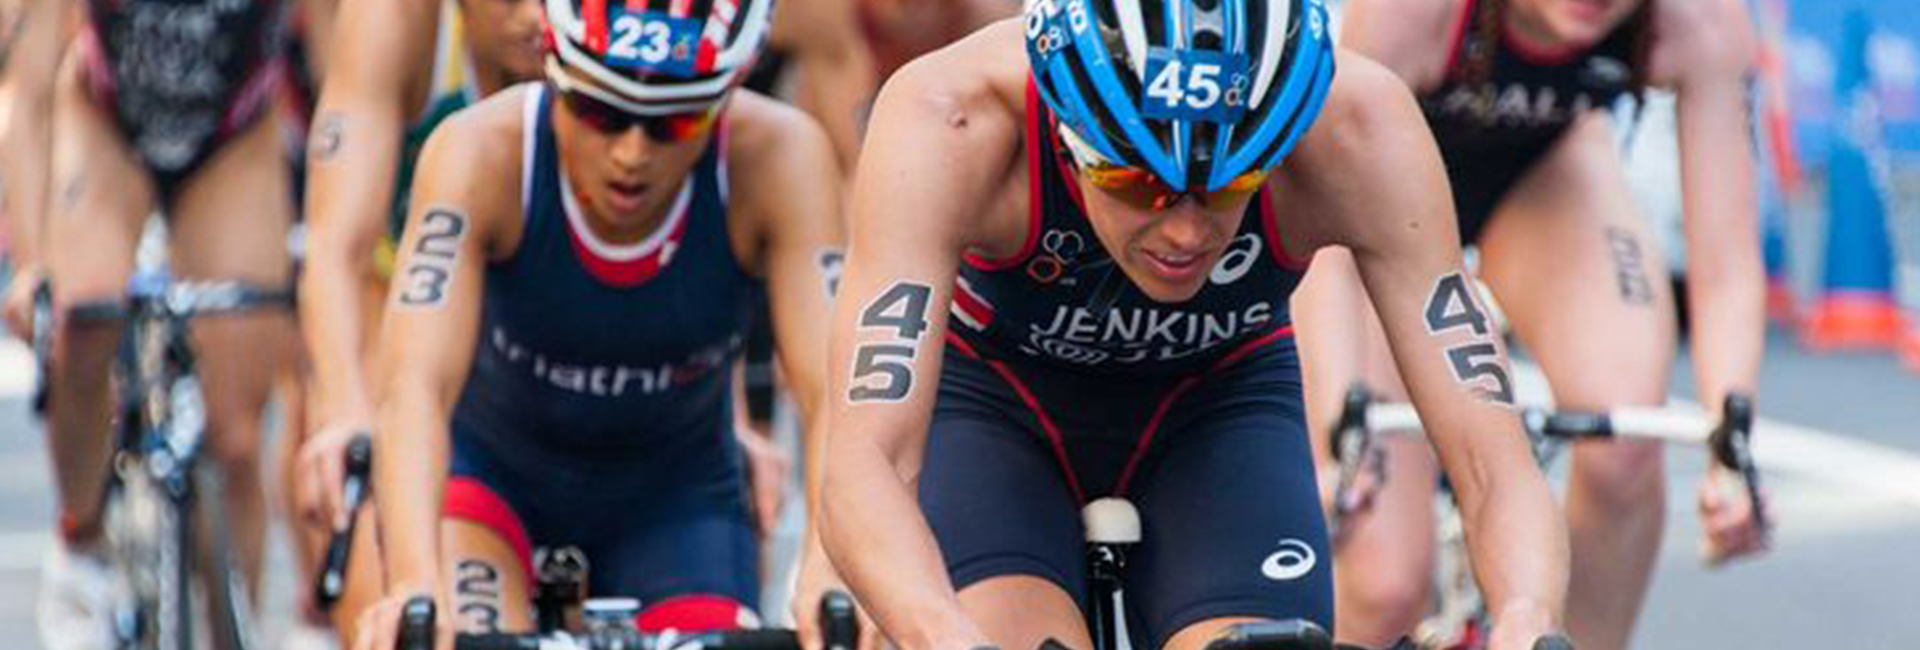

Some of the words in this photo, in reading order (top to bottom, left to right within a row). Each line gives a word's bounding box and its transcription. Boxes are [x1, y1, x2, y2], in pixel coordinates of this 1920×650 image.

[608, 15, 671, 64] 23
[1146, 60, 1222, 109] 45
[1027, 302, 1272, 344] JENKINS
